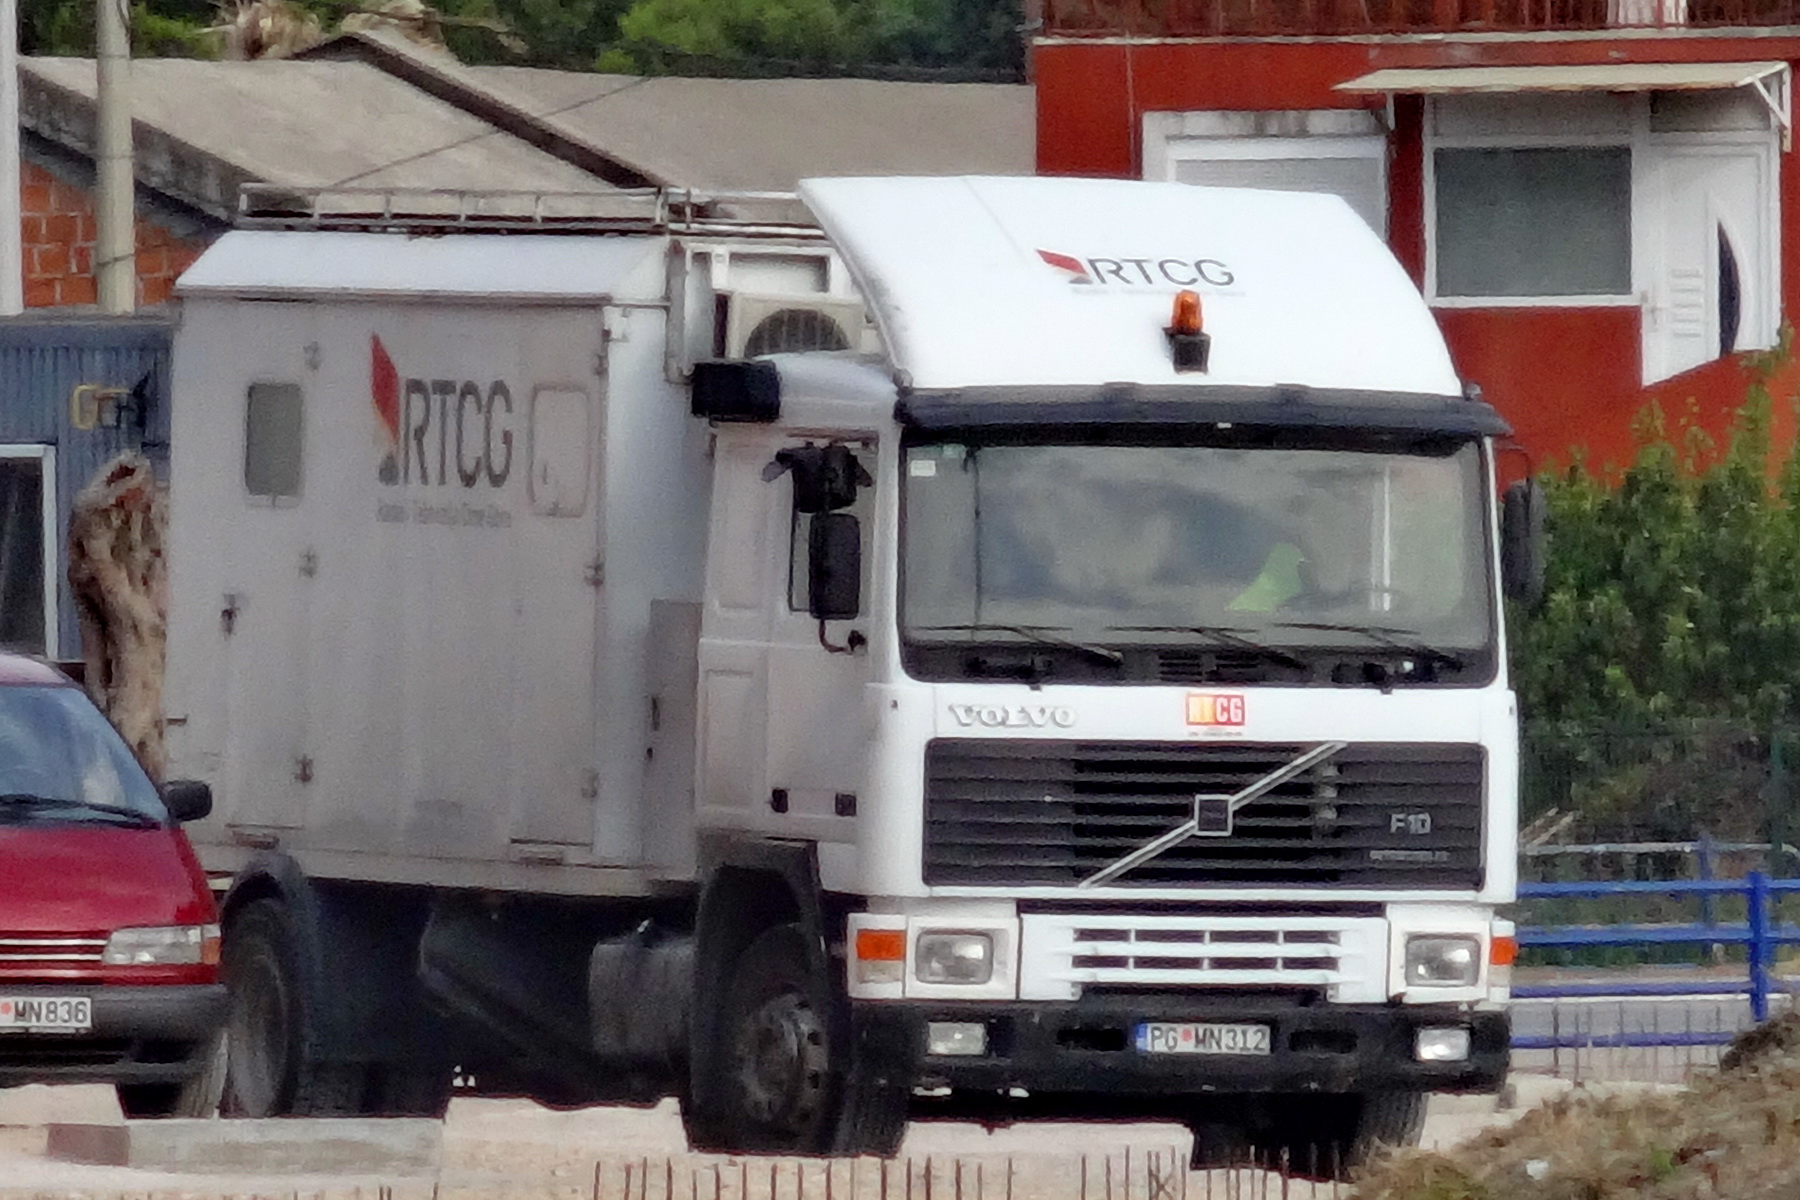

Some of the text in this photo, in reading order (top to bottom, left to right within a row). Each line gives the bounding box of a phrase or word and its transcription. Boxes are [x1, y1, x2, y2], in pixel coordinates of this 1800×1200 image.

[1087, 257, 1235, 287] RTCG
[403, 378, 514, 488] RTCG
[947, 704, 1076, 728] VOLVO
[1151, 1026, 1179, 1051] PG
